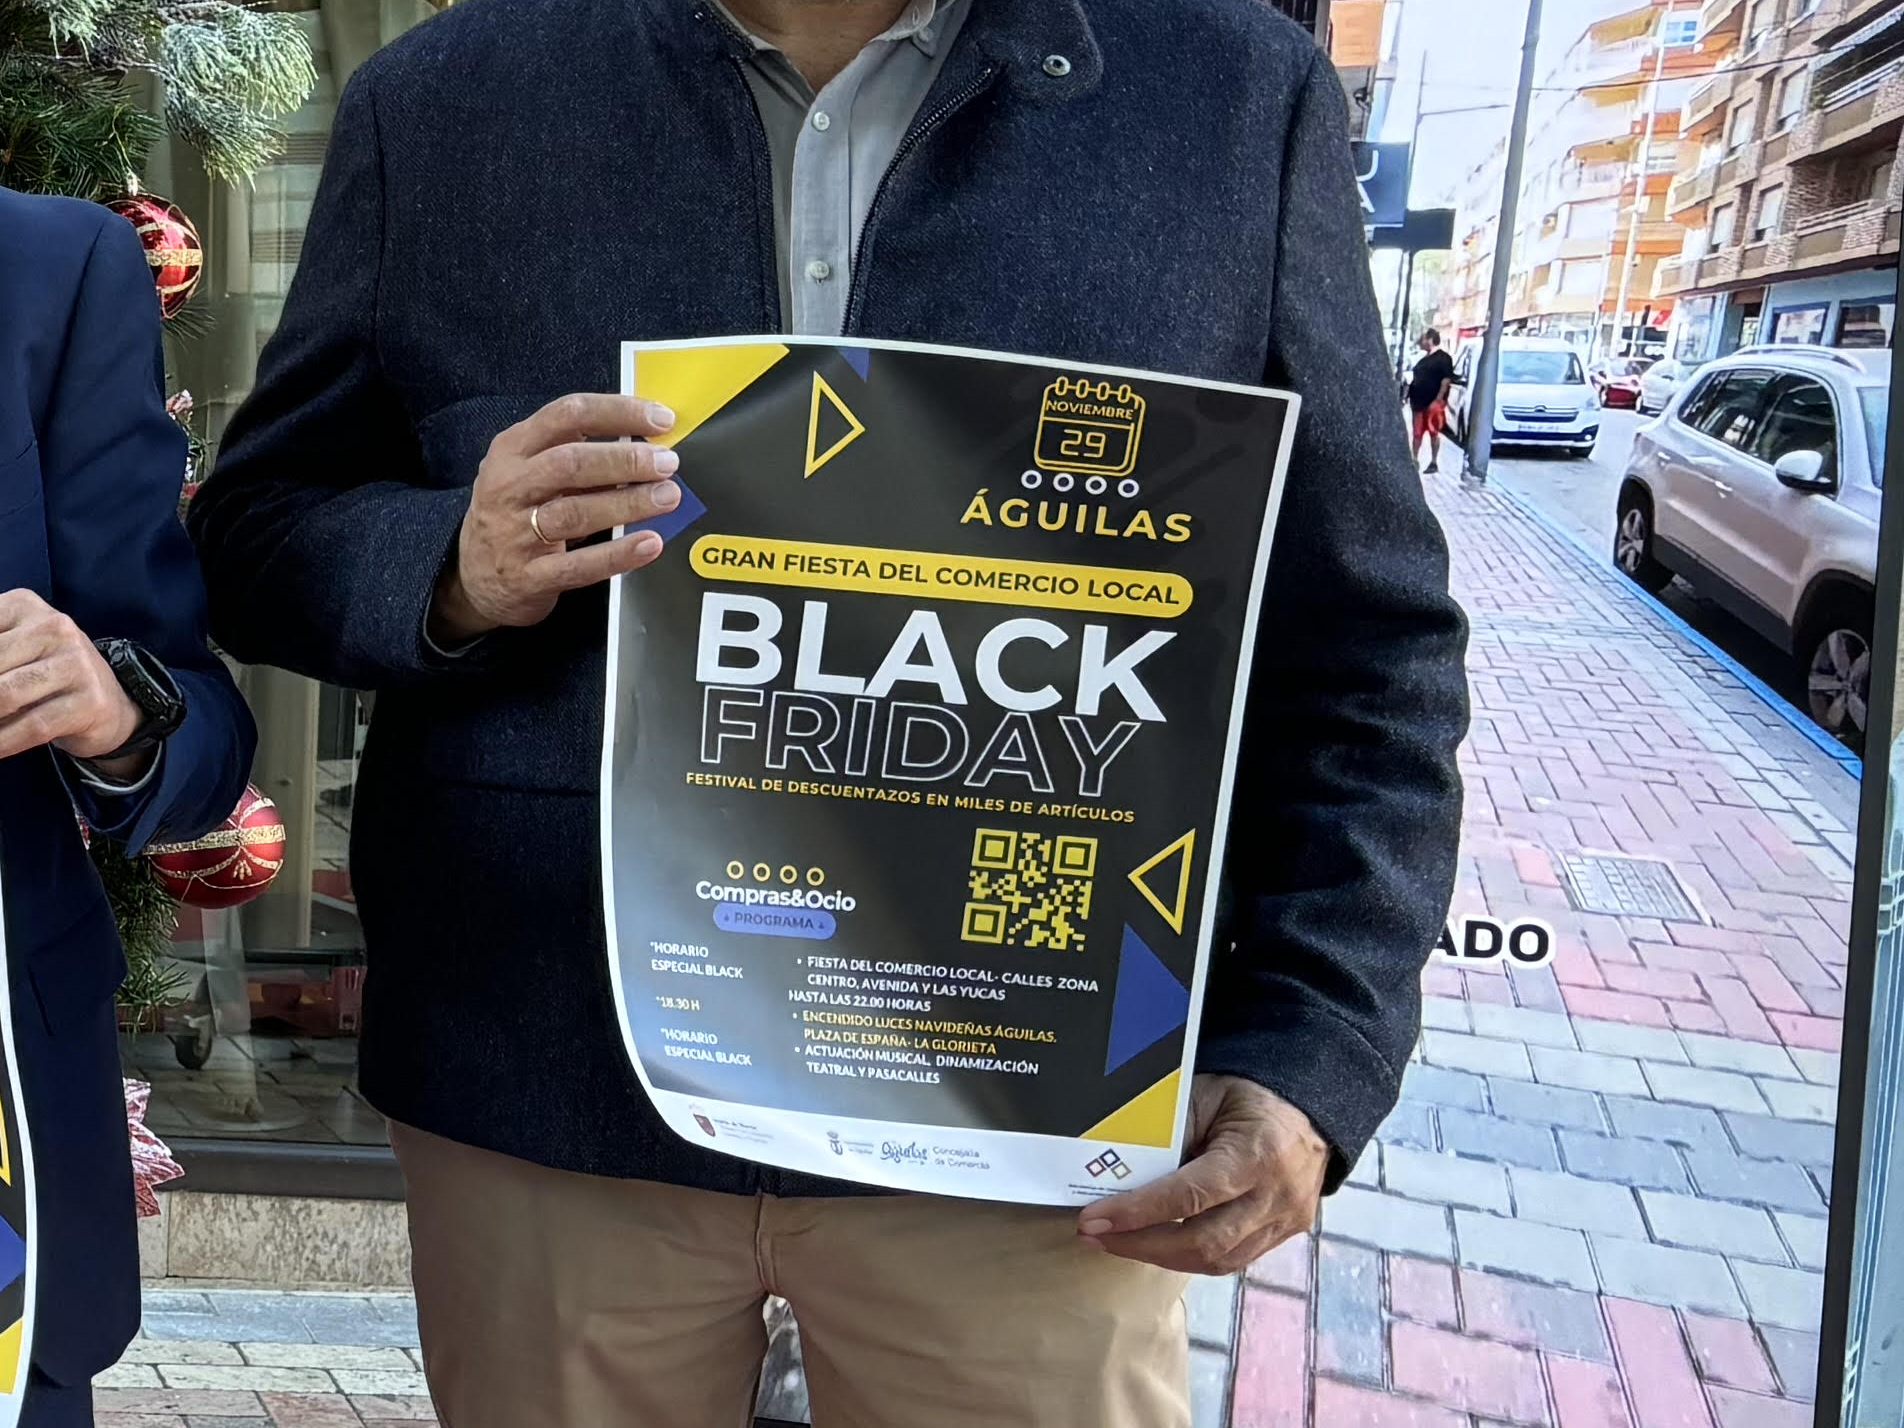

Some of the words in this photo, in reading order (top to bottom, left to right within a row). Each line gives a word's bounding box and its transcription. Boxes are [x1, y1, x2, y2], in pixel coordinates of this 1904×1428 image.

[1046, 400, 1133, 420] NOVIEMBRE
[1060, 430, 1105, 458] 29
[960, 489, 1192, 543] ÁGUILAS
[702, 547, 776, 570] GRAN
[783, 553, 871, 579] FIESTA
[879, 562, 928, 583] DEL
[935, 567, 1079, 595] COMERCIO
[1087, 579, 1180, 605] LOCAL
[695, 592, 1177, 722] BLACK
[700, 685, 1142, 796] FRIDAY
[685, 771, 757, 790] FESTIVAL
[761, 778, 783, 792] DE
[787, 780, 921, 804] DESCUENTAZOS
[926, 793, 949, 806] EN
[954, 795, 1005, 812] MILES
[1010, 800, 1033, 814] DE
[1037, 803, 1135, 823] ARTÍCULOS
[696, 880, 856, 912] Compras&Ocio
[734, 913, 814, 930] PROGRAMA
[806, 955, 849, 971] FIESTA
[849, 958, 874, 973] DEL
[875, 960, 949, 978] COMERCIO
[1001, 972, 1053, 988] CALLES
[1057, 977, 1099, 992] ZONA
